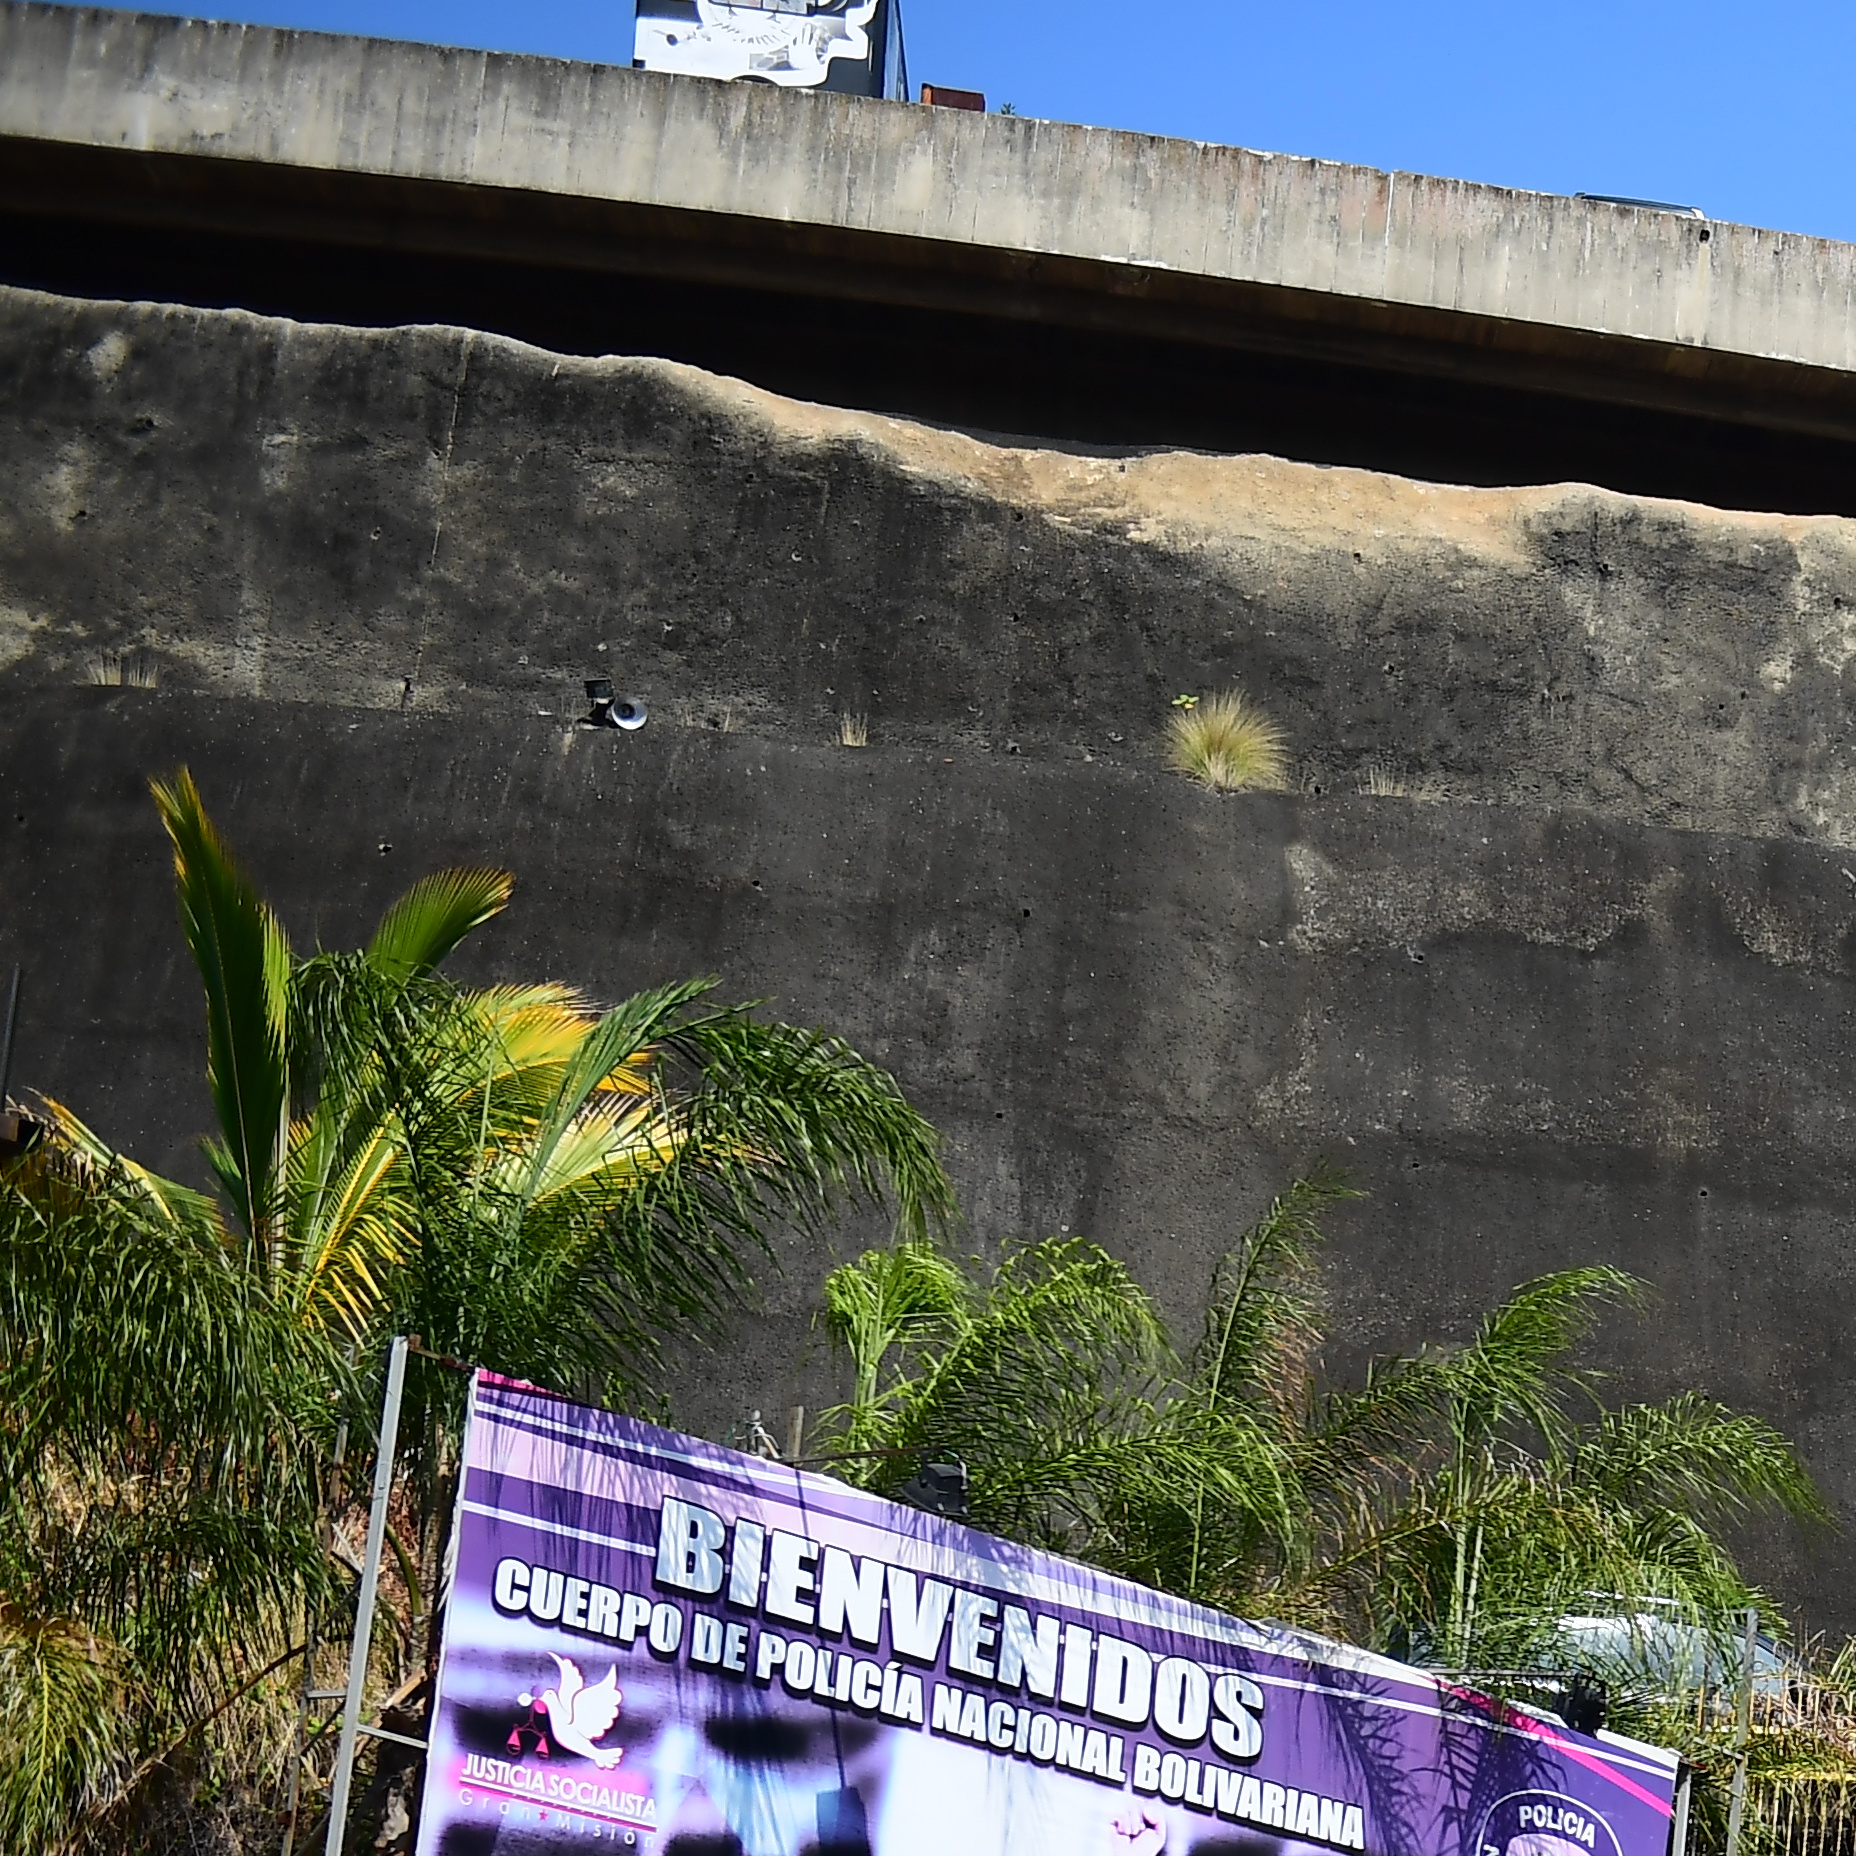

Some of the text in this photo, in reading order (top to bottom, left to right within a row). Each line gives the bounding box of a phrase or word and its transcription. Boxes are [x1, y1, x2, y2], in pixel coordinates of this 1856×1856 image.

[655, 1496, 1264, 1757] BIENVENIDOS
[495, 1558, 1365, 1850] CUERPO DE POLICÍA NACIONAL BOLIVARIANA
[458, 1788, 655, 1848] Gran Misión
[461, 1753, 658, 1819] JUSTICIA SOCIALISTA
[1518, 1805, 1596, 1848] POLICIA
